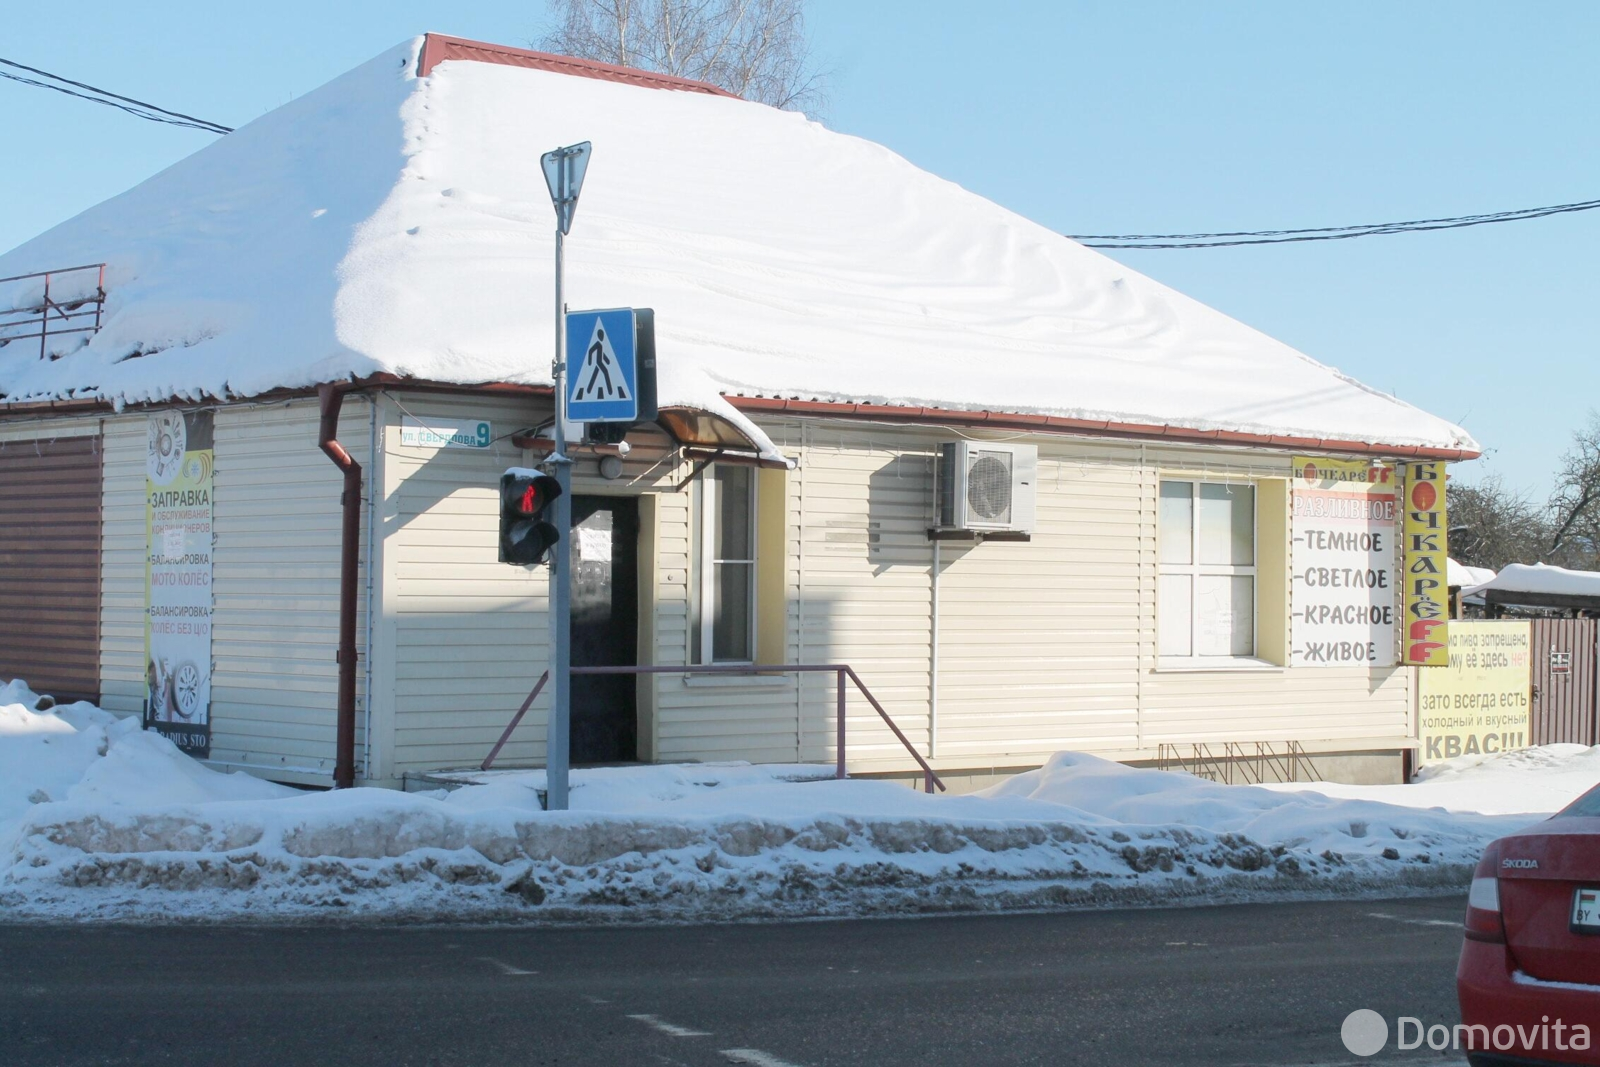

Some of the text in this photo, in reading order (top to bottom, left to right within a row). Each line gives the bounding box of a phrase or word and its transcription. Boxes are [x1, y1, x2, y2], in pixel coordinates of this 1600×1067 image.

[402, 432, 416, 443] ул.
[476, 423, 490, 448] 9
[151, 489, 210, 509] ЗАПРАВКА
[1293, 495, 1394, 520] РАЗЛИВНОЕ
[151, 509, 210, 521] И ОБСЛУЖИВАНИЕ
[151, 572, 176, 586] МОТО
[150, 605, 209, 618] БАЛАНСИРОВКА
[177, 622, 192, 635] БЕЗ
[1459, 633, 1478, 647] пива
[1480, 633, 1528, 650] запрещена,
[1480, 652, 1508, 670] здесь
[1511, 652, 1527, 667] нет
[1422, 692, 1527, 711] зато всегда есть
[1422, 712, 1527, 729] холодный и вкусный
[1425, 732, 1524, 760] КВАС!!!
[1576, 909, 1590, 921] BY
